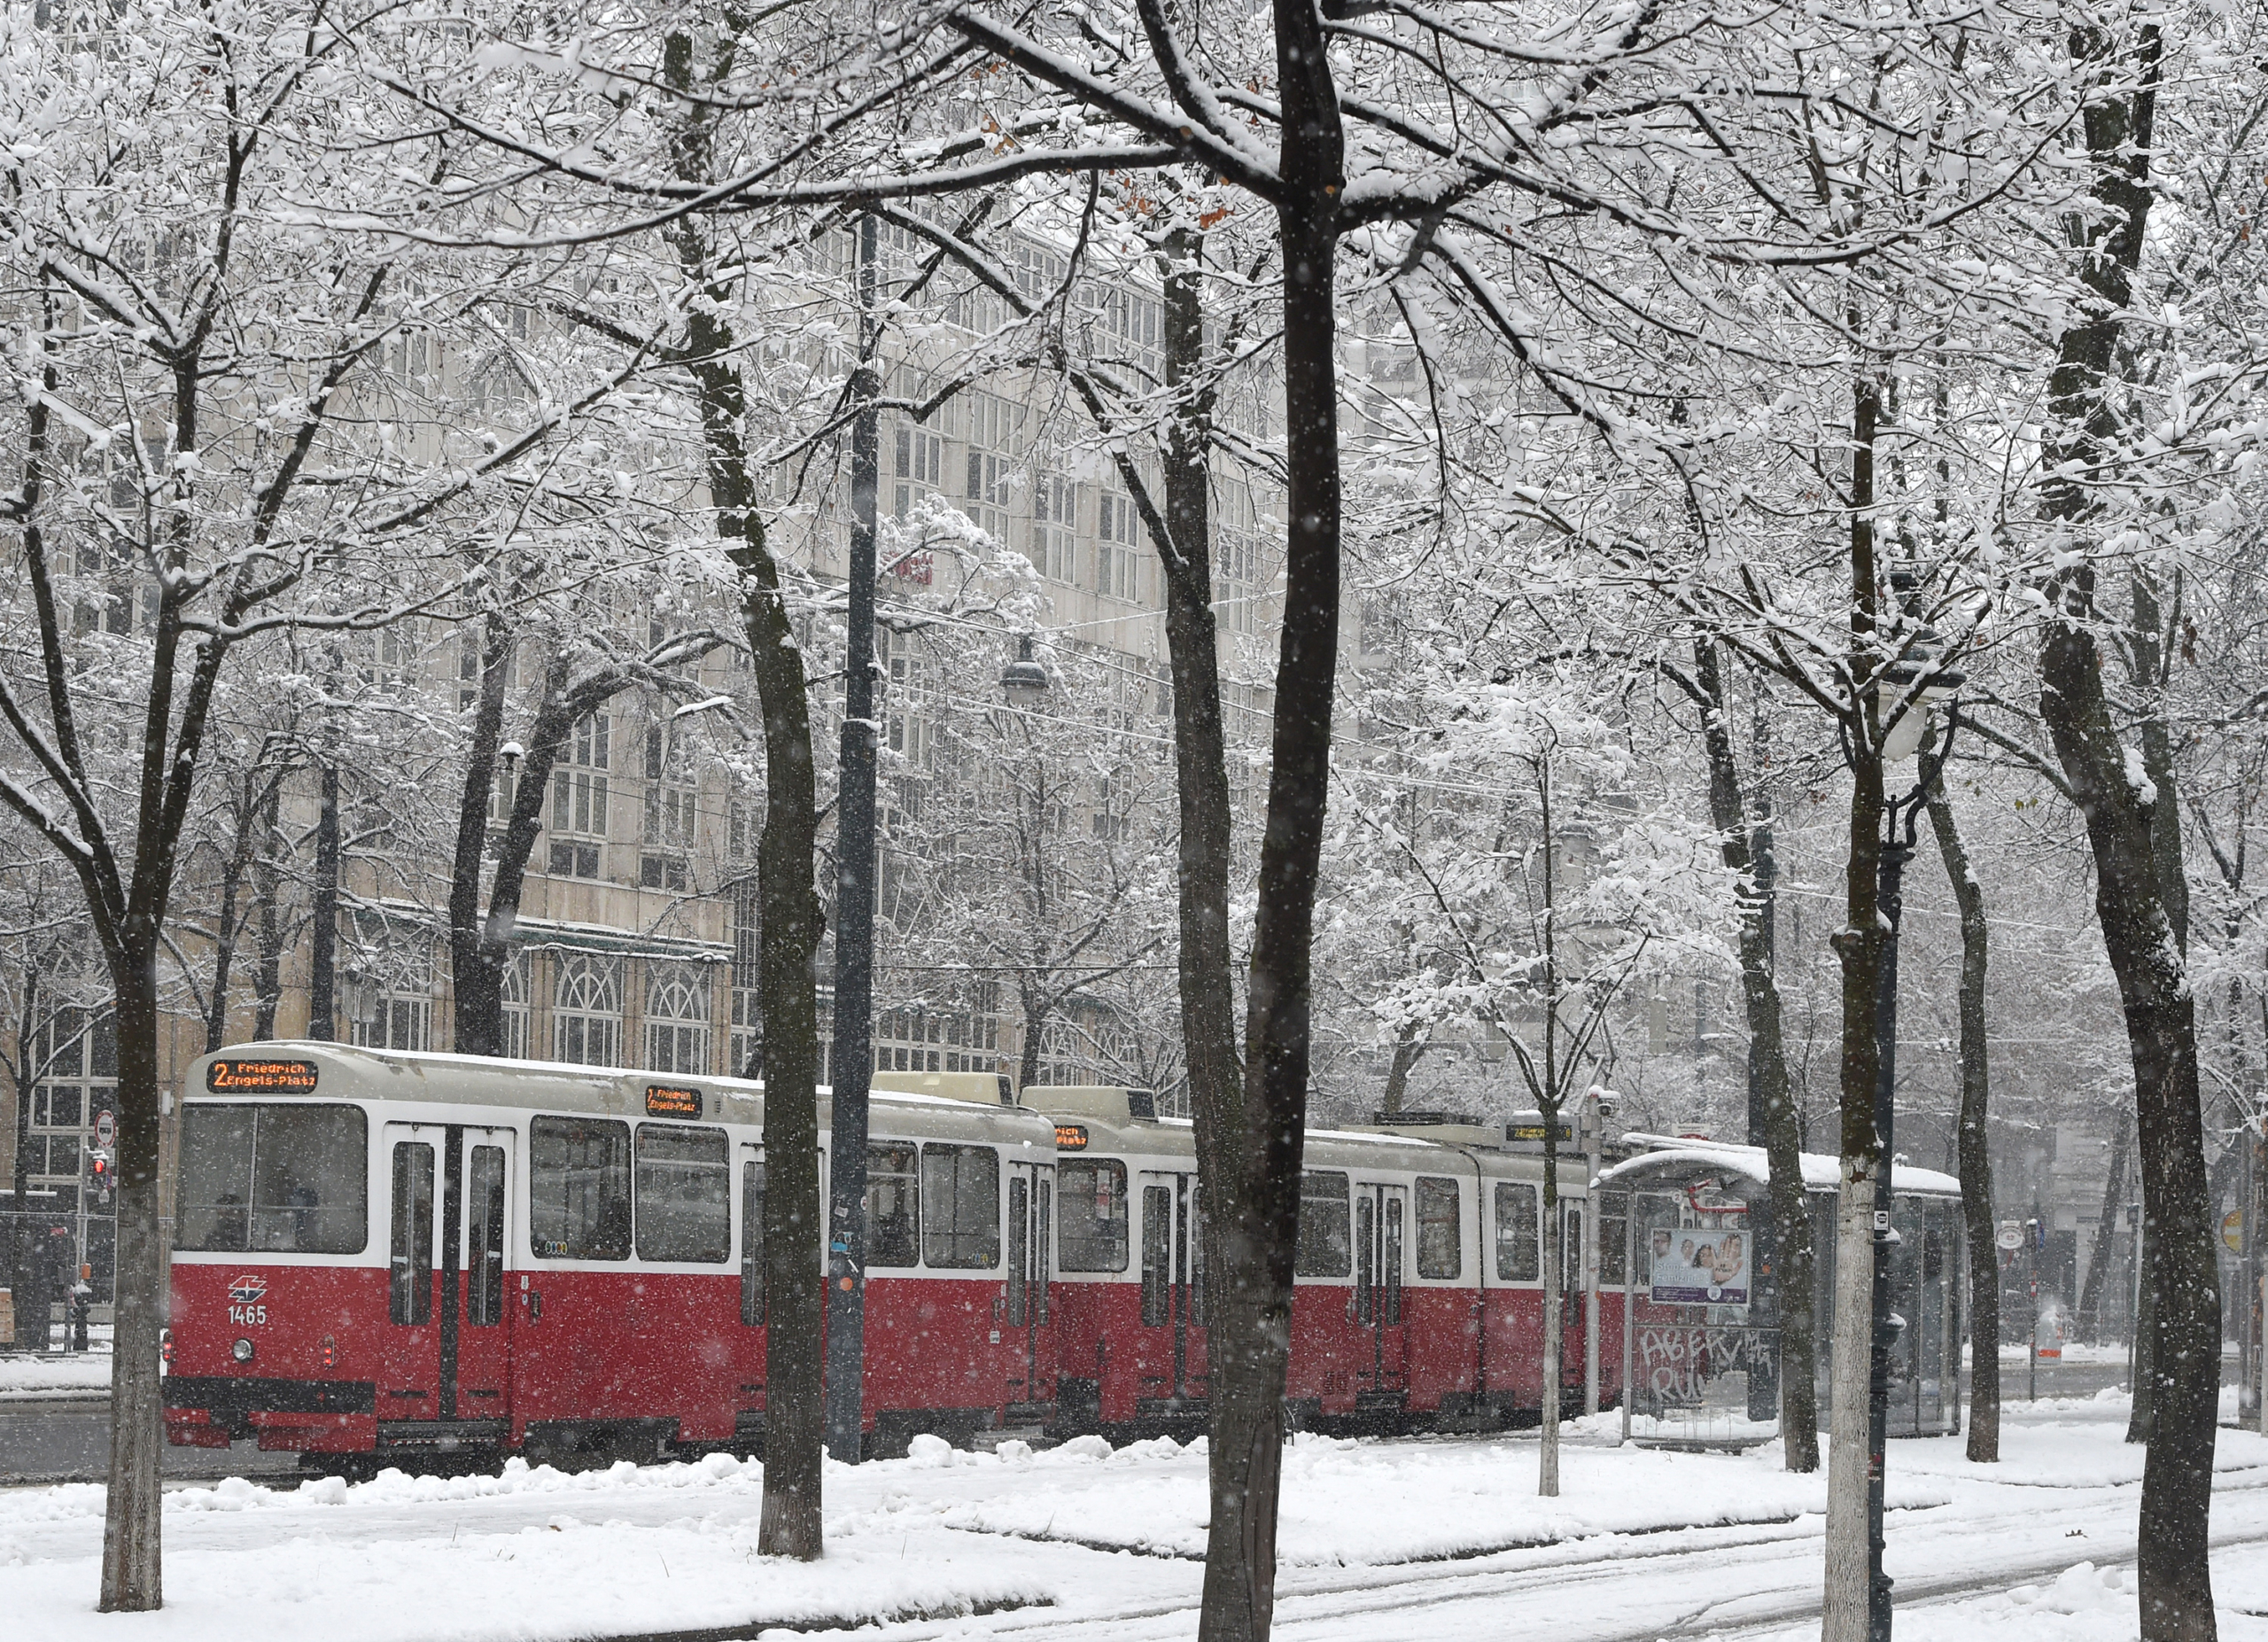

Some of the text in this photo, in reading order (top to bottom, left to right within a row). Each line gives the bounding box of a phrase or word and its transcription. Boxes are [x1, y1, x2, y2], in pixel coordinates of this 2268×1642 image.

[214, 1062, 229, 1086] 2
[237, 1063, 307, 1074] Friedrich
[227, 1075, 315, 1086] Engels-Platz
[228, 1304, 267, 1326] 1465
